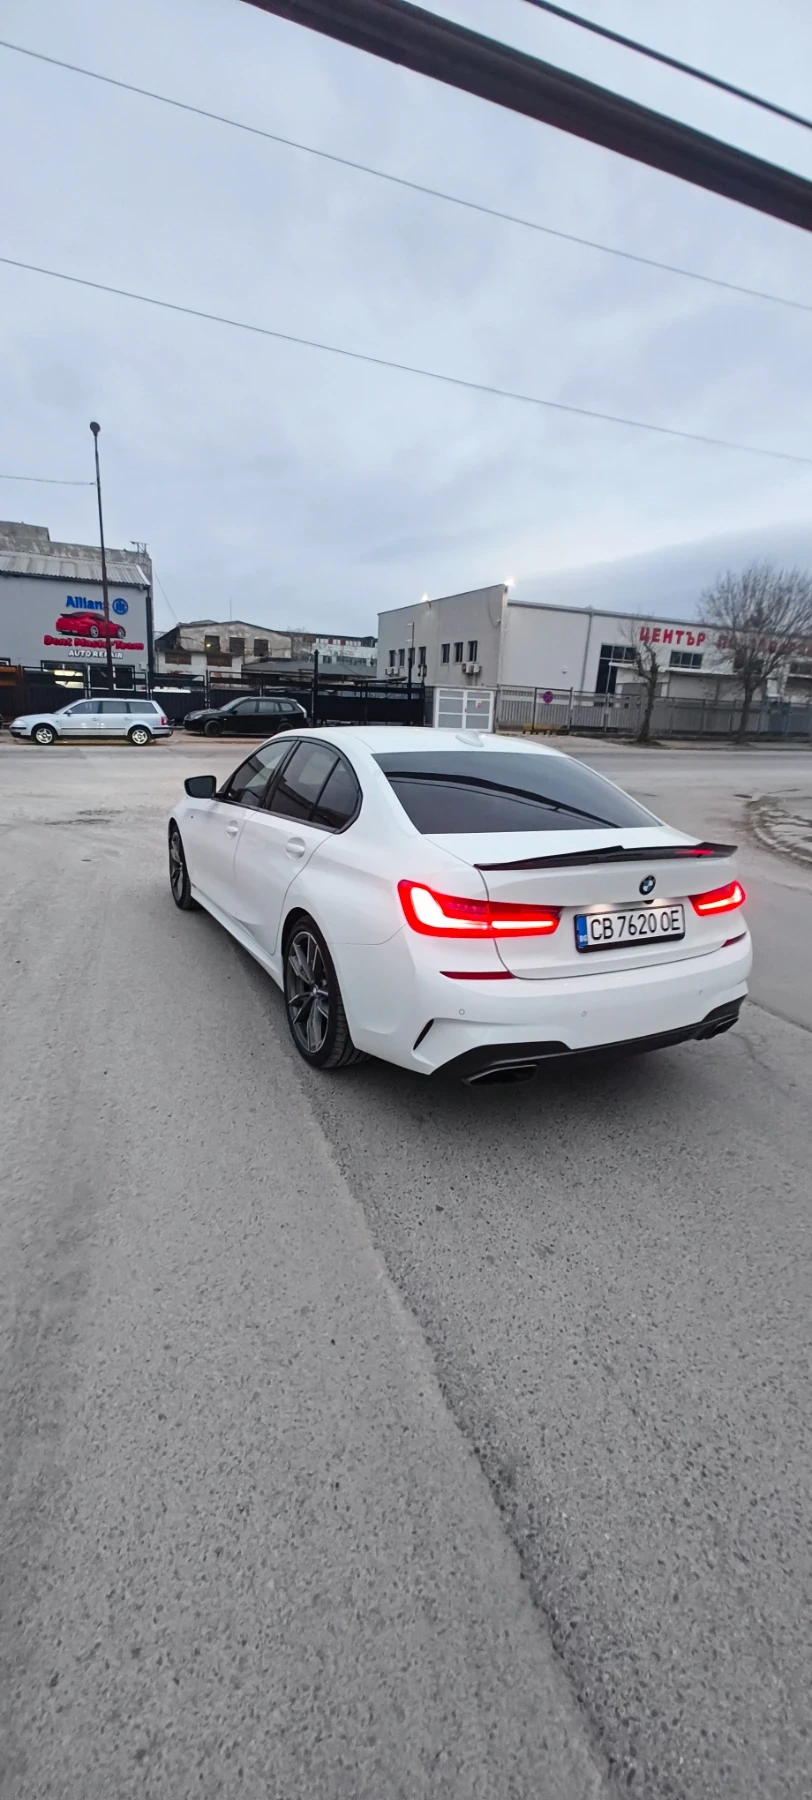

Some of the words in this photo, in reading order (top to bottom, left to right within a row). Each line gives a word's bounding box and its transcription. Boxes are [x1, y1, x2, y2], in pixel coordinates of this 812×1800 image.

[66, 596, 107, 610] Allian
[639, 626, 706, 647] ЦЕНТЪР
[68, 649, 91, 658] AUTO
[591, 917, 614, 941] CB
[617, 912, 657, 938] 7620
